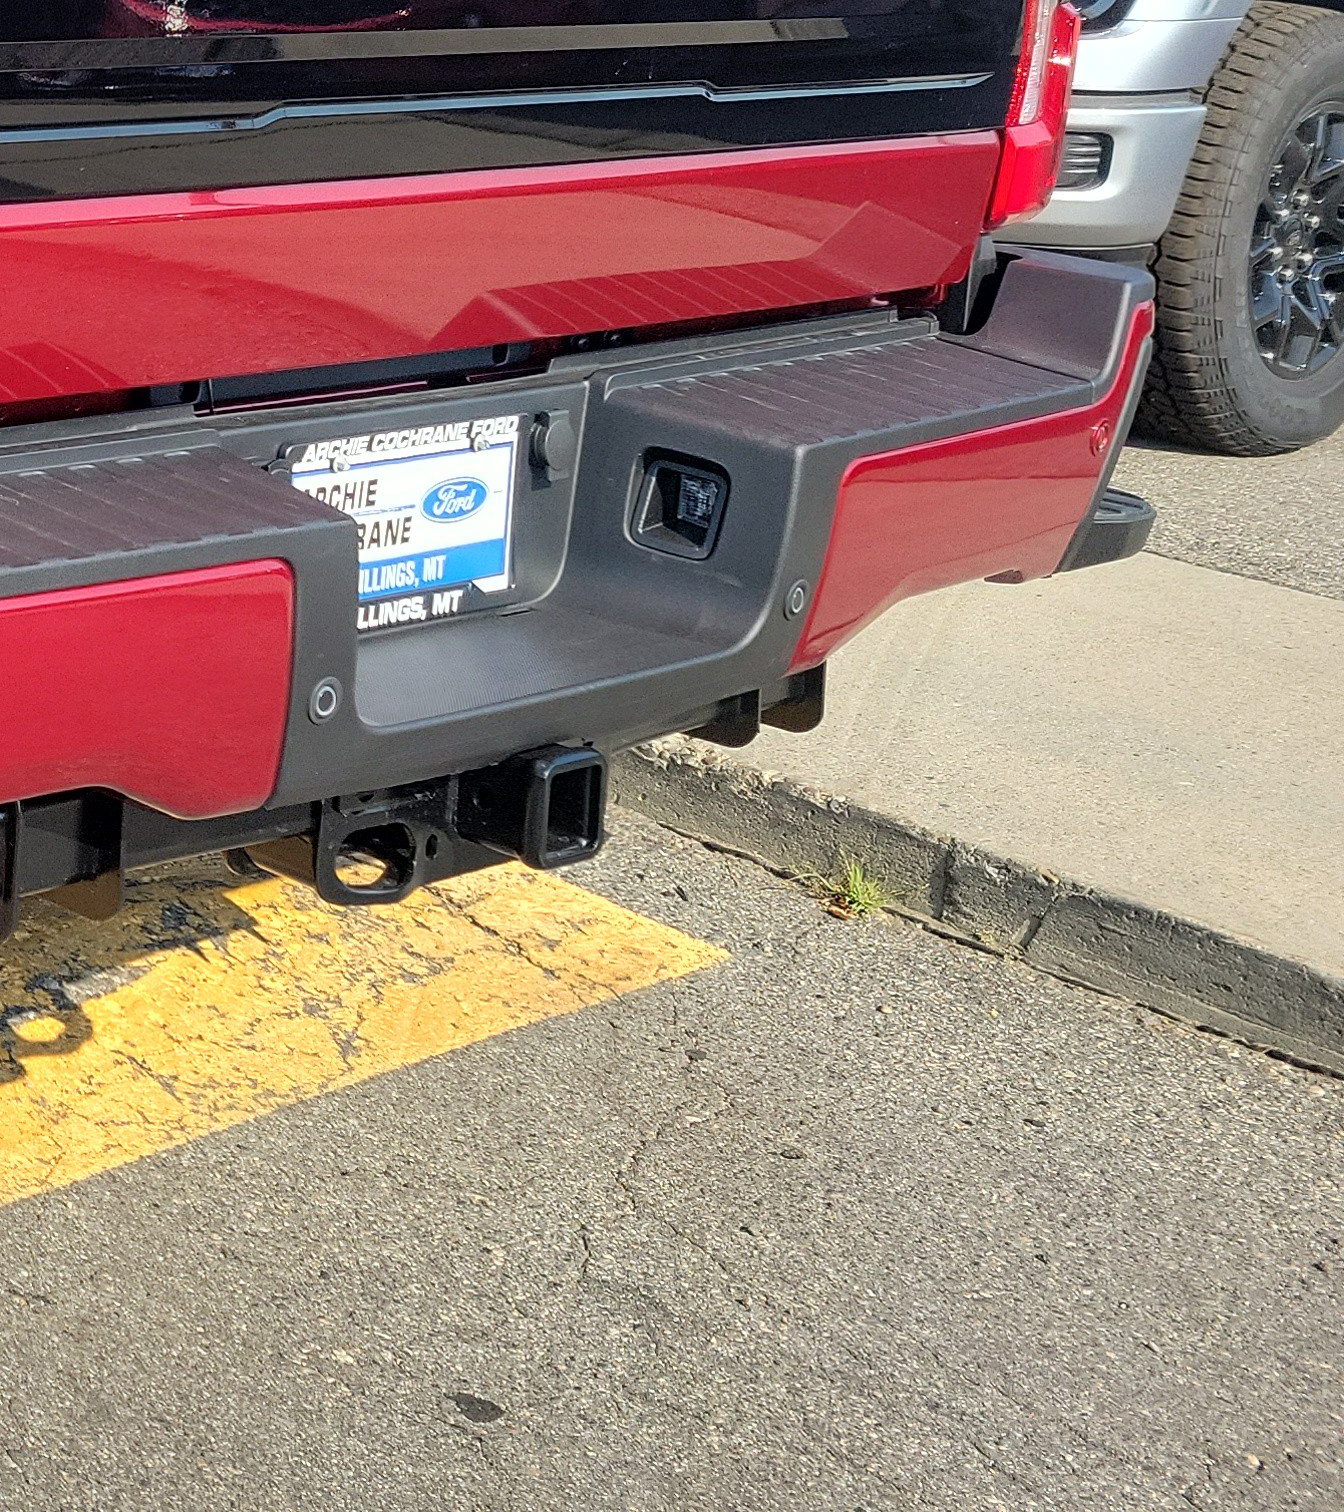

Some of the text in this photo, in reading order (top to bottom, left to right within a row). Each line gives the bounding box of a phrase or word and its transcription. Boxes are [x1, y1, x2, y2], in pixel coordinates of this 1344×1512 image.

[302, 415, 519, 464] ARCHIE COCHRANE FORD
[305, 478, 476, 516] RCHIE Ford
[358, 555, 447, 594] ILLINGS, MT
[432, 589, 464, 616] MT
